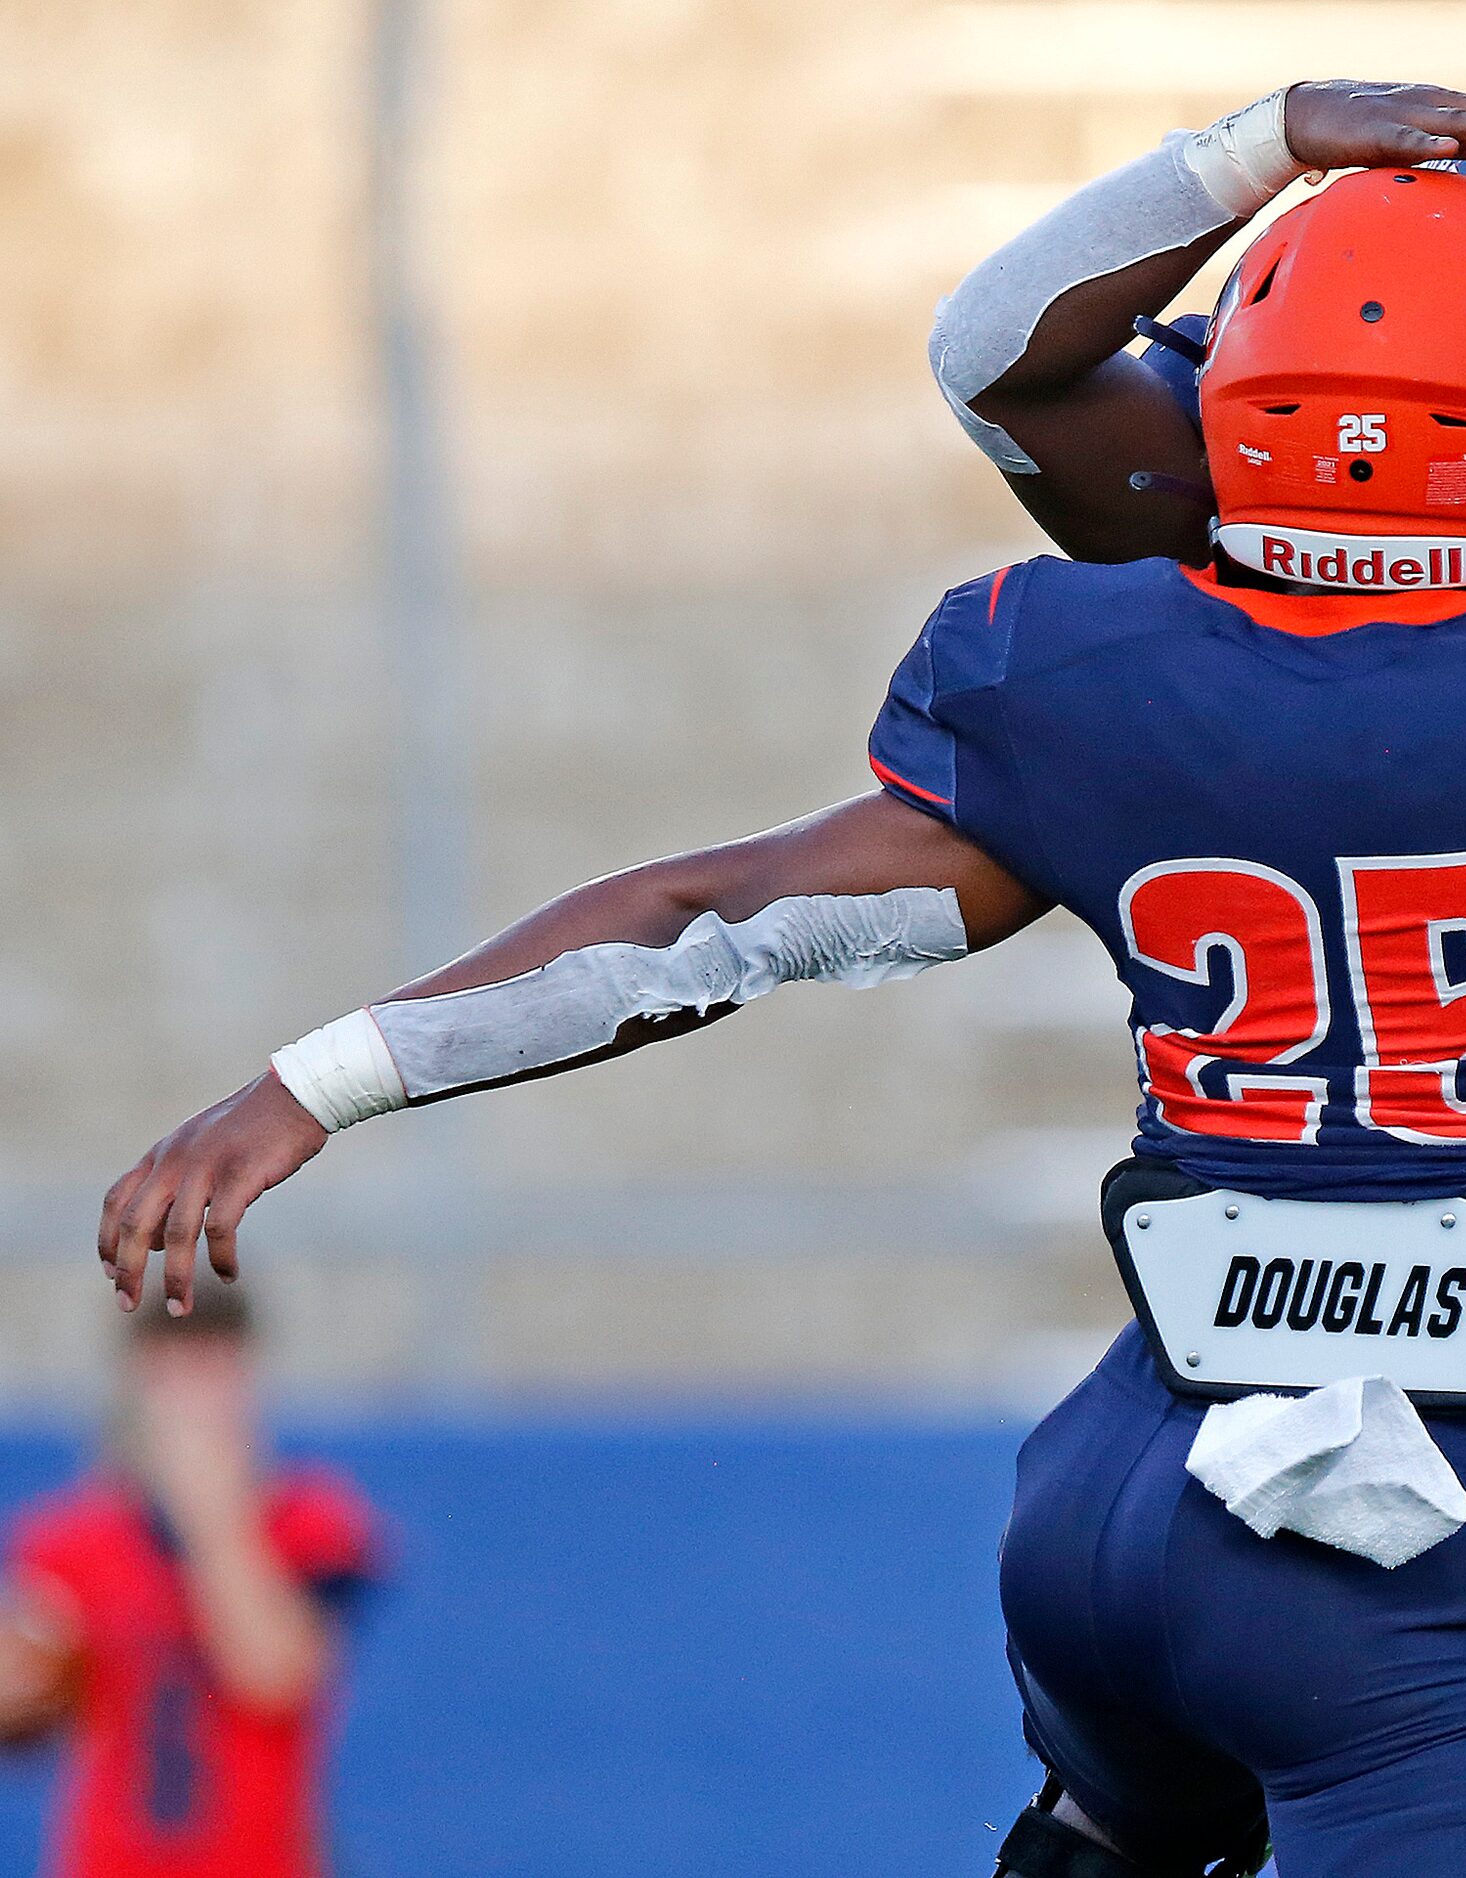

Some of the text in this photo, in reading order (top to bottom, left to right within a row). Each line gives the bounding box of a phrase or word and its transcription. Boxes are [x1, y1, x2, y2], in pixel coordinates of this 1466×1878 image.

[1238, 443, 1271, 461] Riddell
[1338, 413, 1387, 453] 25
[1262, 534, 1464, 586] Riddell
